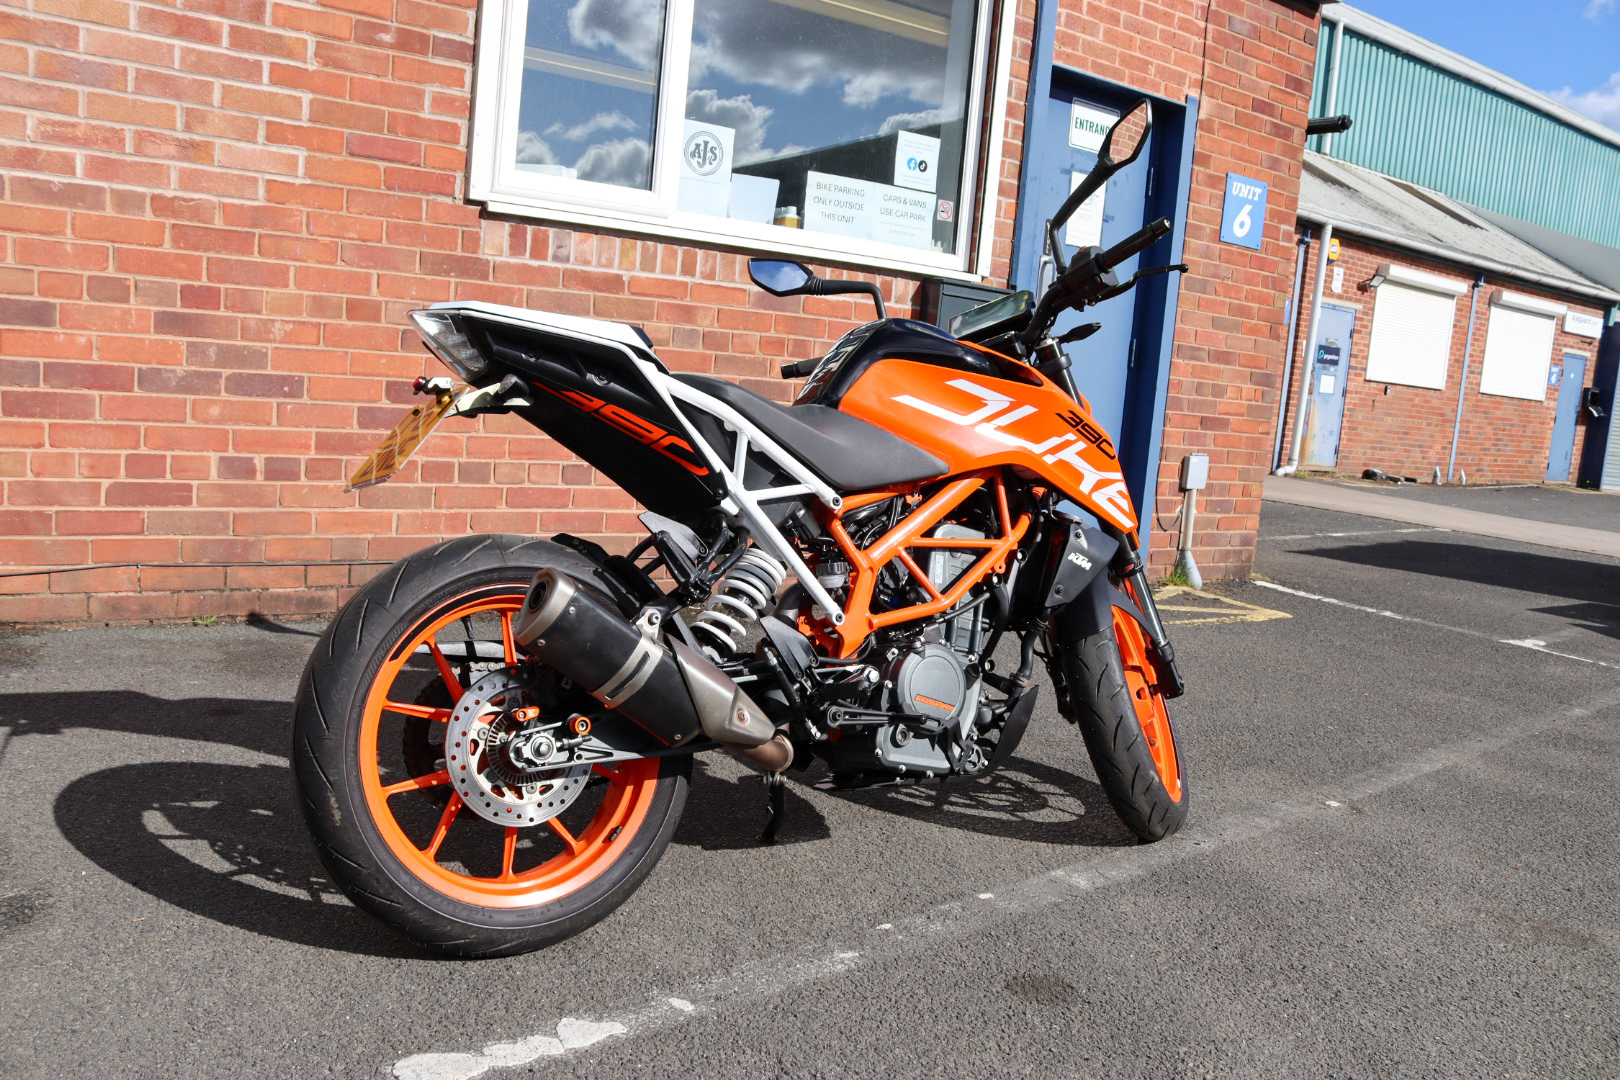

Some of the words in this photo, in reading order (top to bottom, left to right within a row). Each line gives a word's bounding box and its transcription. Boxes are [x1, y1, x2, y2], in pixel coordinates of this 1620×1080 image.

[1074, 116, 1110, 137] ENTRANC
[816, 181, 833, 192] BIKE
[834, 184, 865, 198] PARKING
[1232, 181, 1262, 201] UNIT
[813, 196, 833, 206] ONLY
[833, 199, 865, 212] OUTSIDE
[883, 193, 902, 204] CARS
[902, 197, 908, 205] &
[909, 198, 927, 209] VANS
[820, 211, 836, 222] THIS
[837, 213, 855, 224] UNIT
[880, 207, 894, 217] USE
[895, 209, 909, 219] CAR
[909, 212, 926, 222] PARK
[1233, 203, 1253, 238] 6
[1055, 409, 1116, 461] 390
[1067, 551, 1093, 571] KTM
